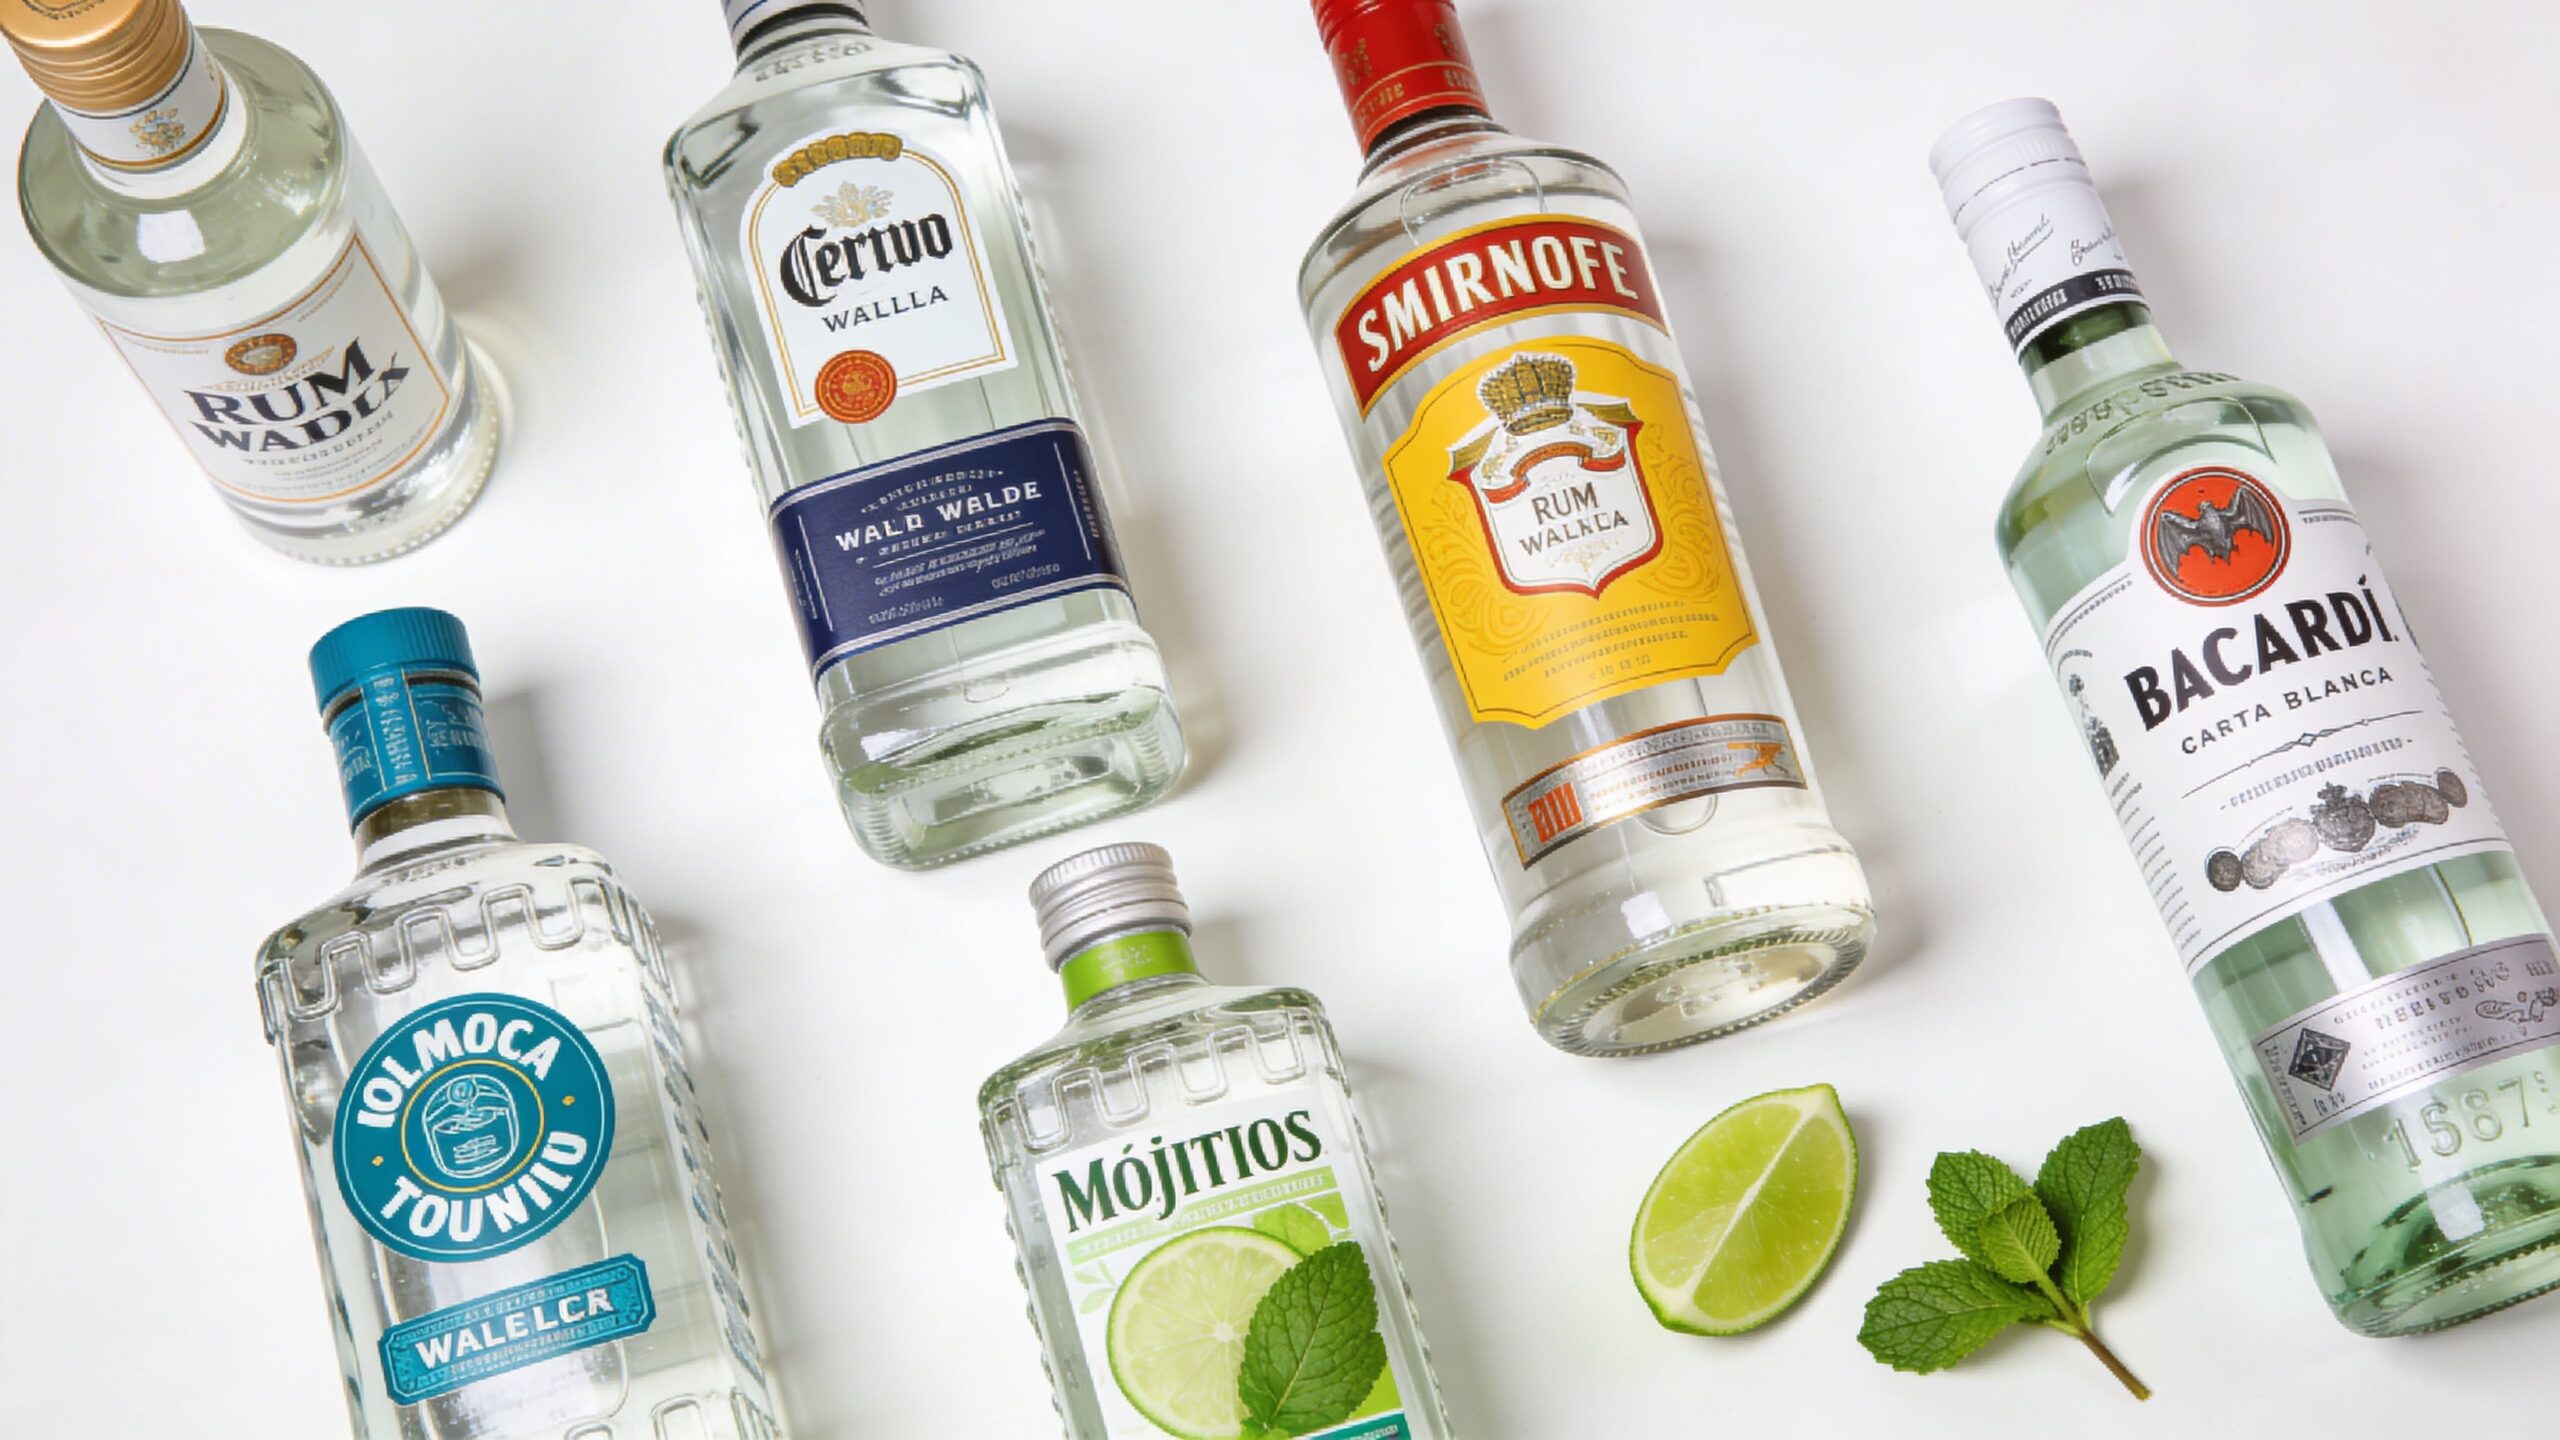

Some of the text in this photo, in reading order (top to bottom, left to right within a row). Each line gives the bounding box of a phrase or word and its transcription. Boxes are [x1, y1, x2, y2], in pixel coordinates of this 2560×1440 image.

[821, 285, 949, 333] WALLLA
[183, 336, 376, 425] RUM
[936, 481, 1042, 521] WALDE
[1531, 482, 1599, 525] RUM
[2123, 574, 2395, 732] BACARDÍ
[2181, 667, 2393, 754] CARTA BLANCA
